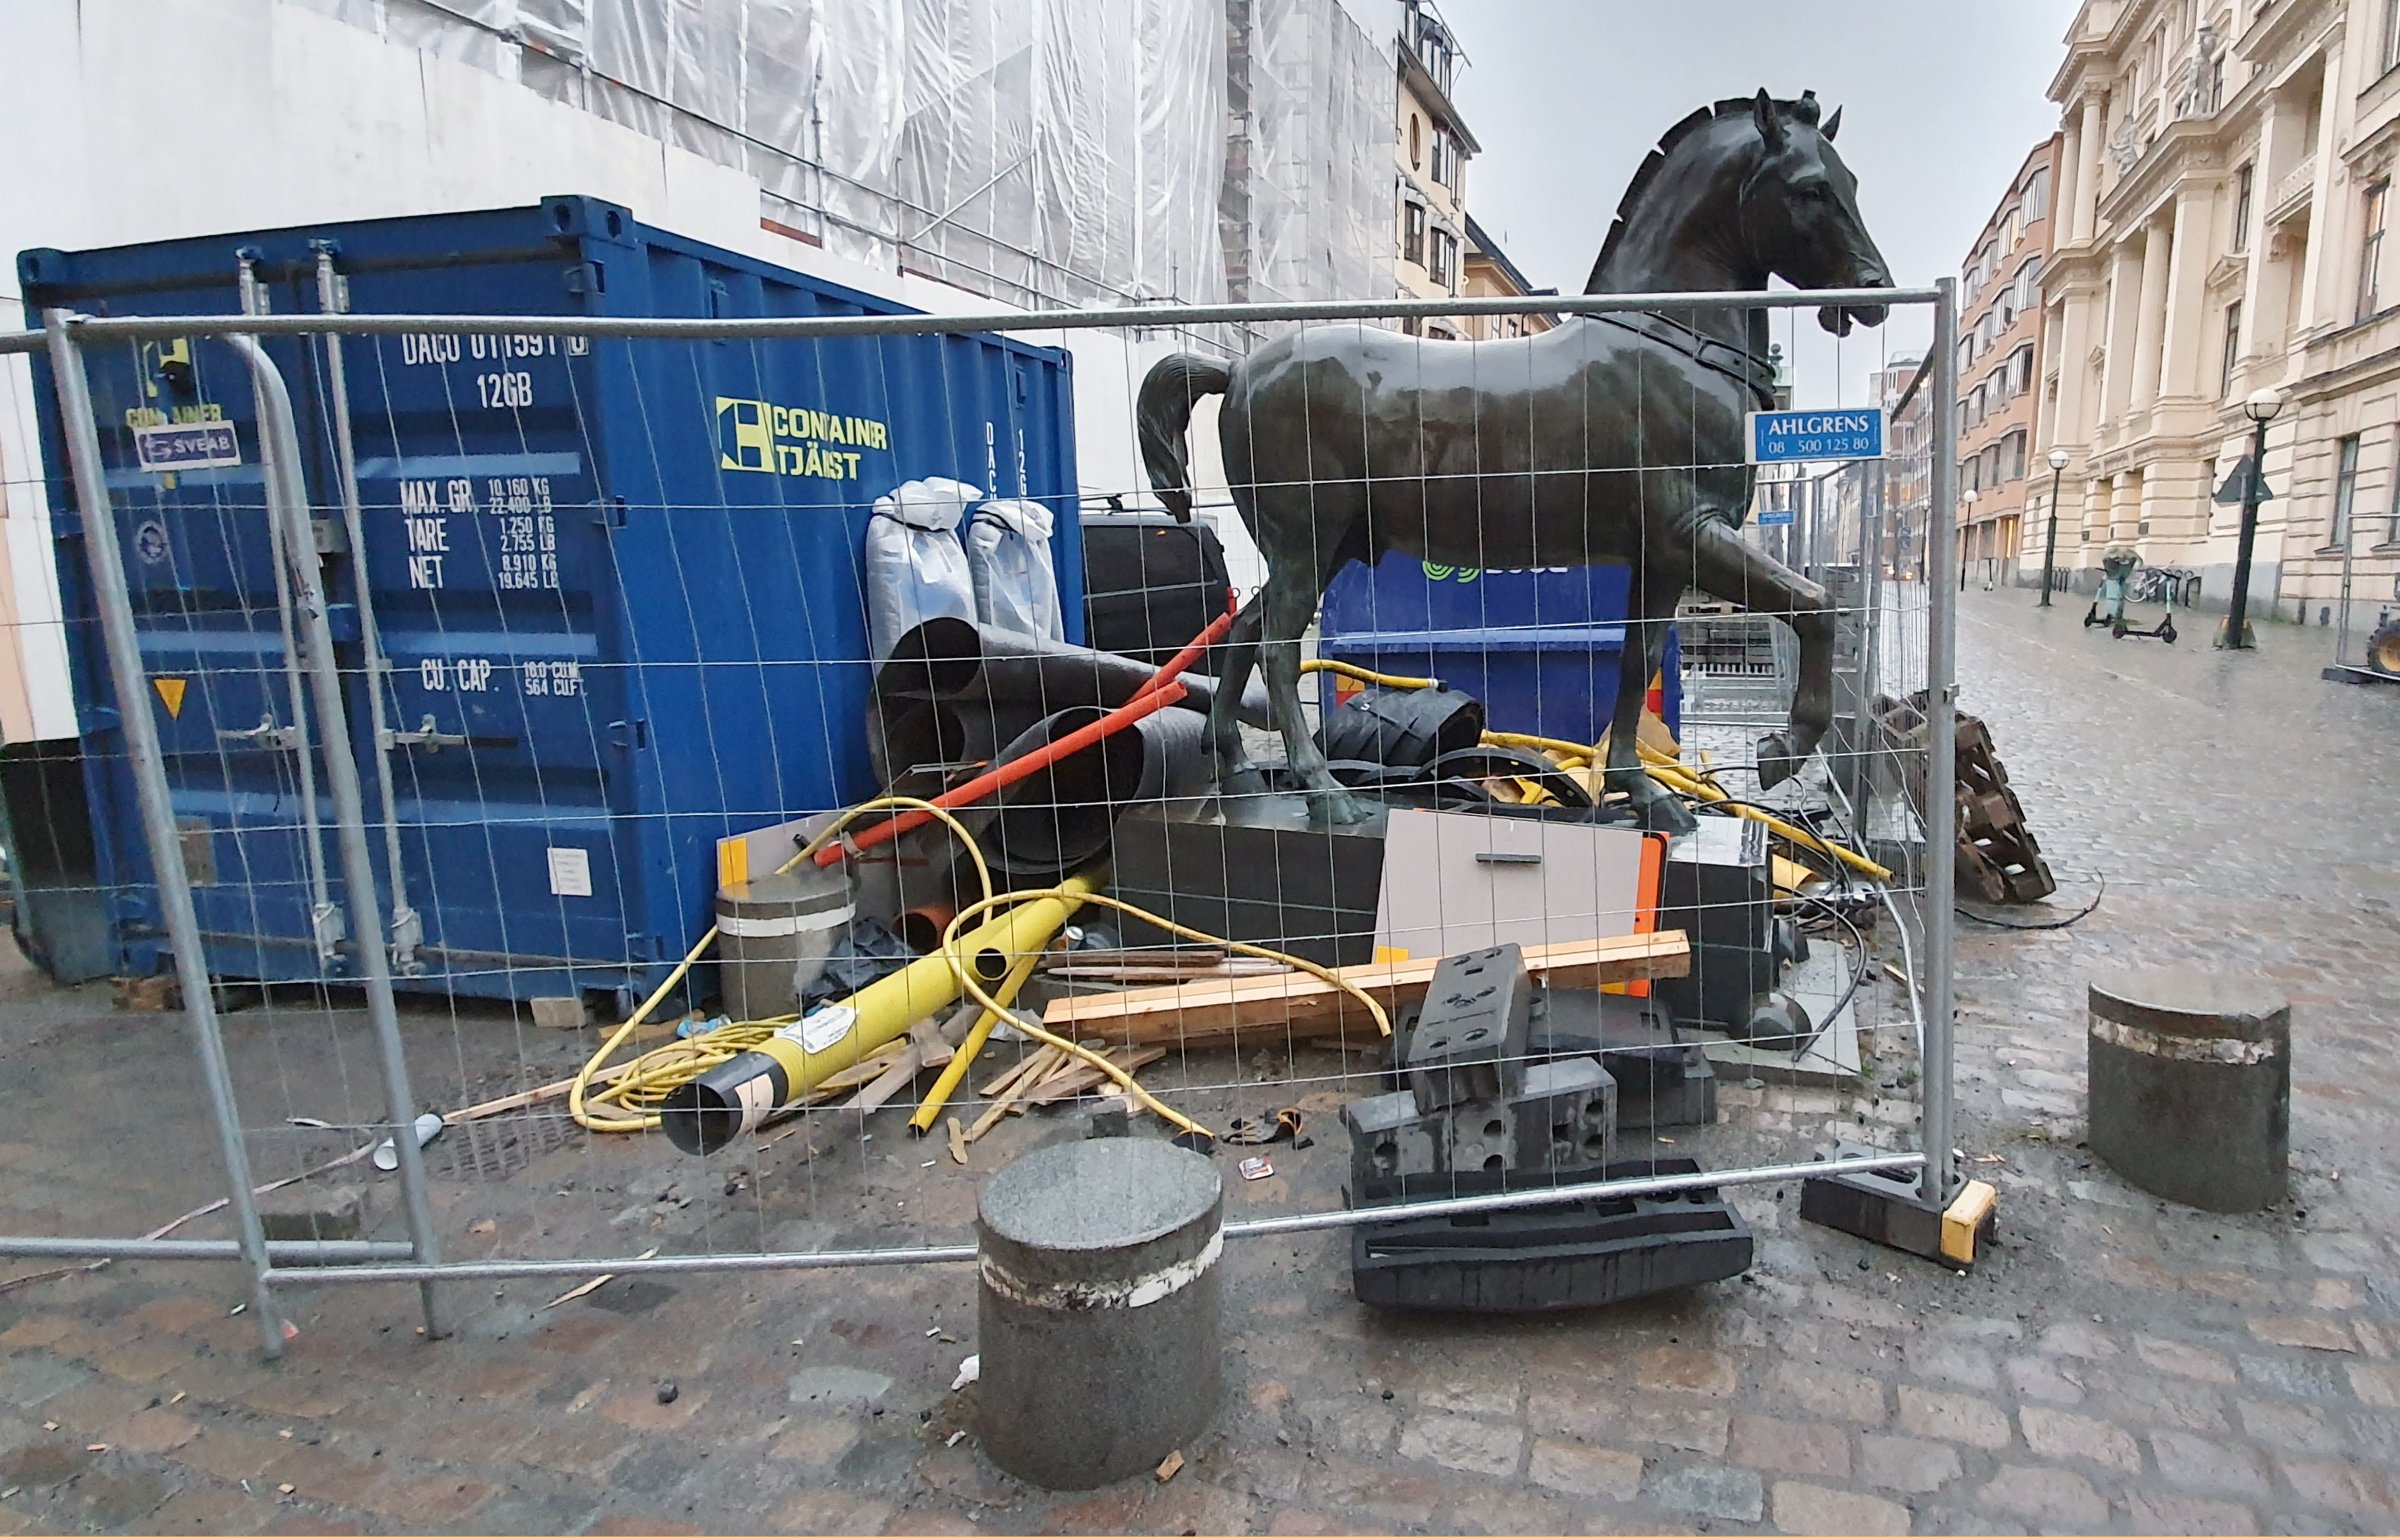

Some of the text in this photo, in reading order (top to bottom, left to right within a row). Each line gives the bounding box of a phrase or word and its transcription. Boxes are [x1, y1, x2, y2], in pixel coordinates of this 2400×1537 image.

[477, 372, 532, 408] 12GB
[1768, 415, 1869, 436] AHLGRENS
[173, 436, 231, 453] SVEAB
[1768, 437, 1869, 454] 08 500 125 80
[400, 480, 445, 515] MAX.
[488, 478, 529, 497] 10.160
[531, 477, 550, 496] KG
[404, 515, 555, 552] TARE 1.250 KG
[500, 534, 556, 552] 2.755 LB
[408, 555, 443, 589] NET
[541, 553, 558, 571] KG
[498, 571, 539, 590] 19.645
[421, 658, 450, 691] CU.
[525, 678, 548, 696] 564
